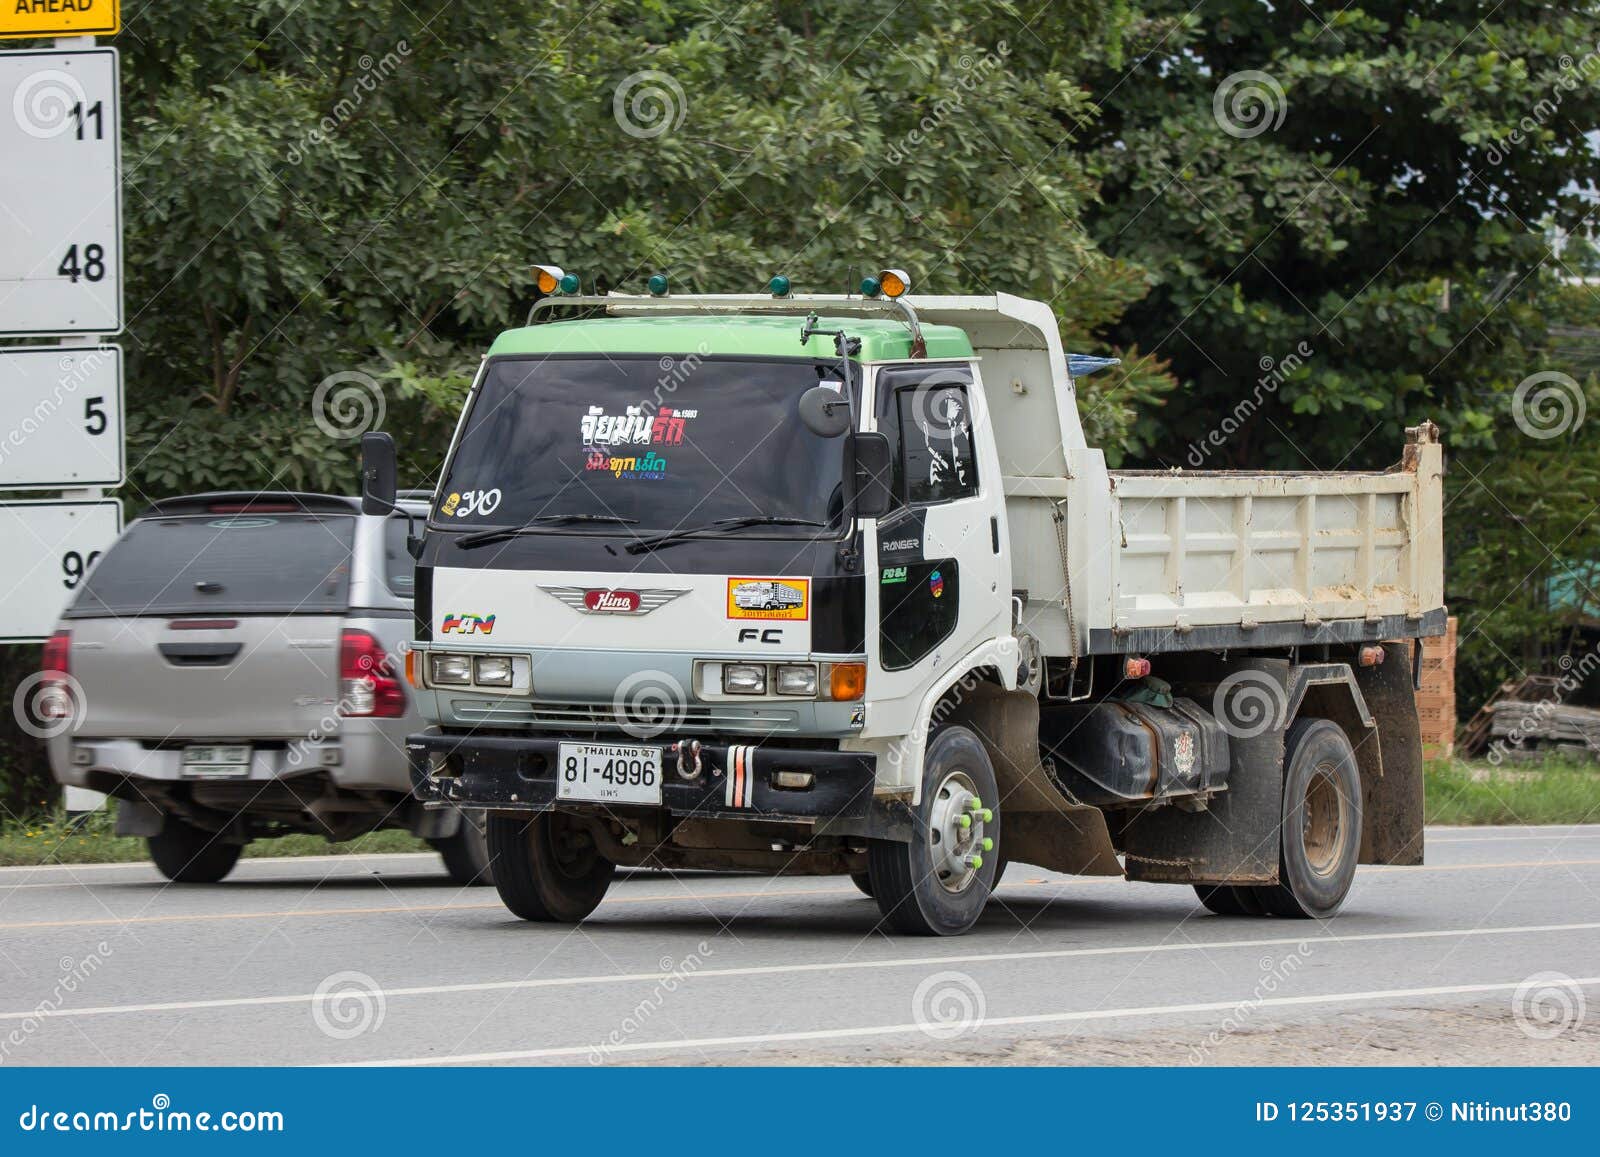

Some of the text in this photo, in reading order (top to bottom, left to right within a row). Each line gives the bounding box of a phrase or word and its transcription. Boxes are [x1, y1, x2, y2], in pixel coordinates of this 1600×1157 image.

[15, 0, 93, 14] AHEAD
[67, 100, 103, 141] 11
[57, 243, 105, 283] 48
[84, 396, 107, 436] 5
[882, 539, 920, 552] RANGER
[62, 550, 102, 590] 9
[592, 591, 631, 611] Hino
[738, 628, 783, 644] FC
[584, 747, 638, 757] THAILAND
[565, 756, 656, 786] 81-4996
